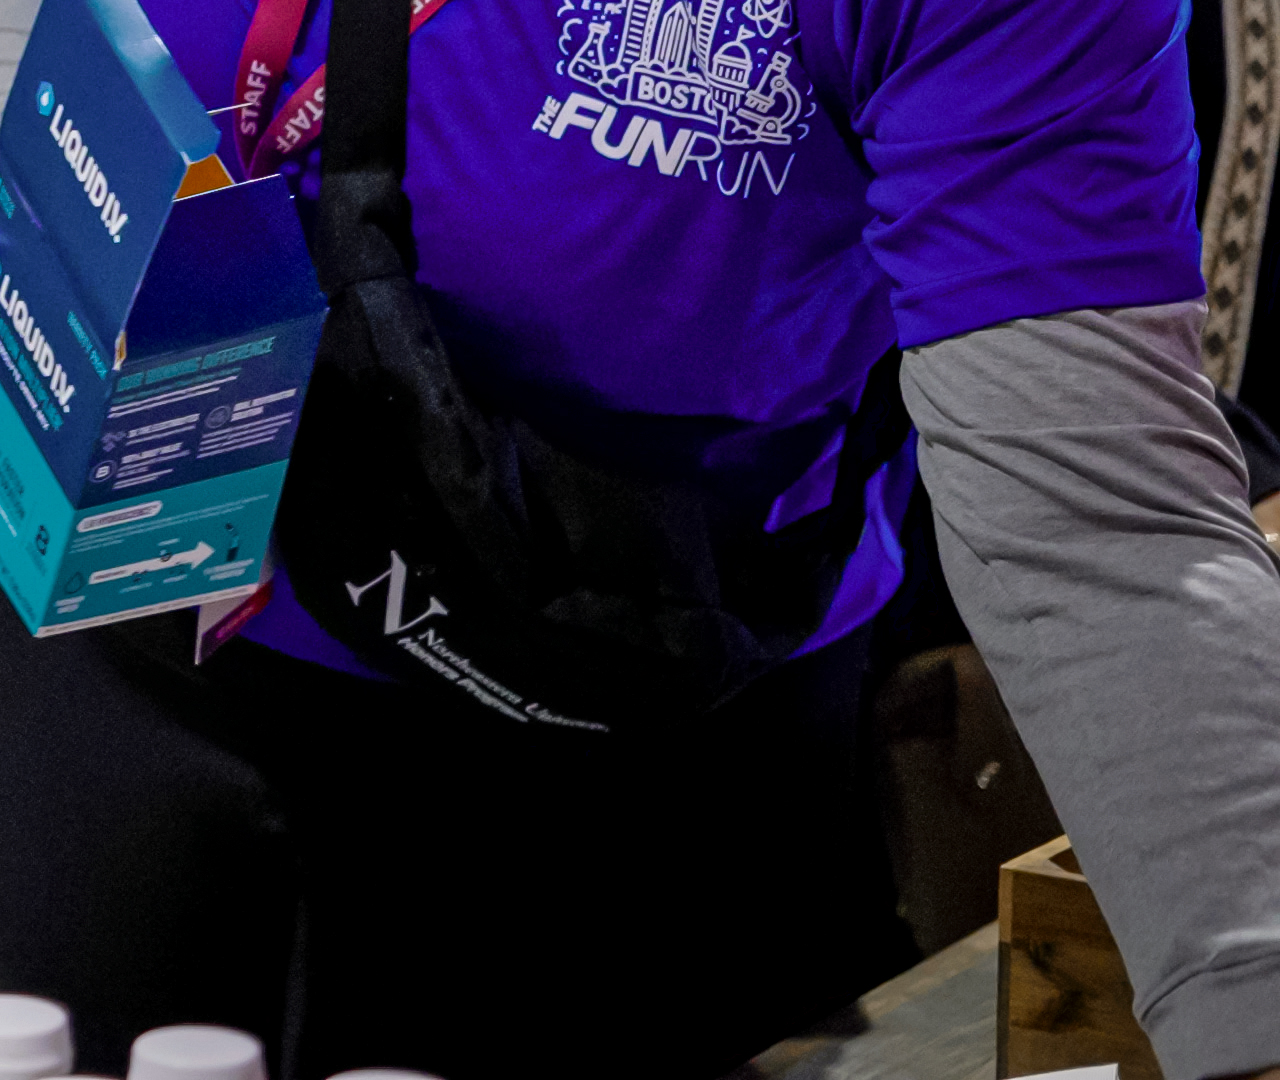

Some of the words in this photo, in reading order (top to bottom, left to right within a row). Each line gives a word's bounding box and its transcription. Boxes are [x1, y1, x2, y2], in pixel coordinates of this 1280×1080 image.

[241, 60, 271, 135] STAFF
[276, 87, 325, 153] STAFF
[532, 96, 561, 132] THE
[638, 75, 716, 116] BOST
[50, 104, 108, 208] LIQUID
[345, 550, 448, 635] N
